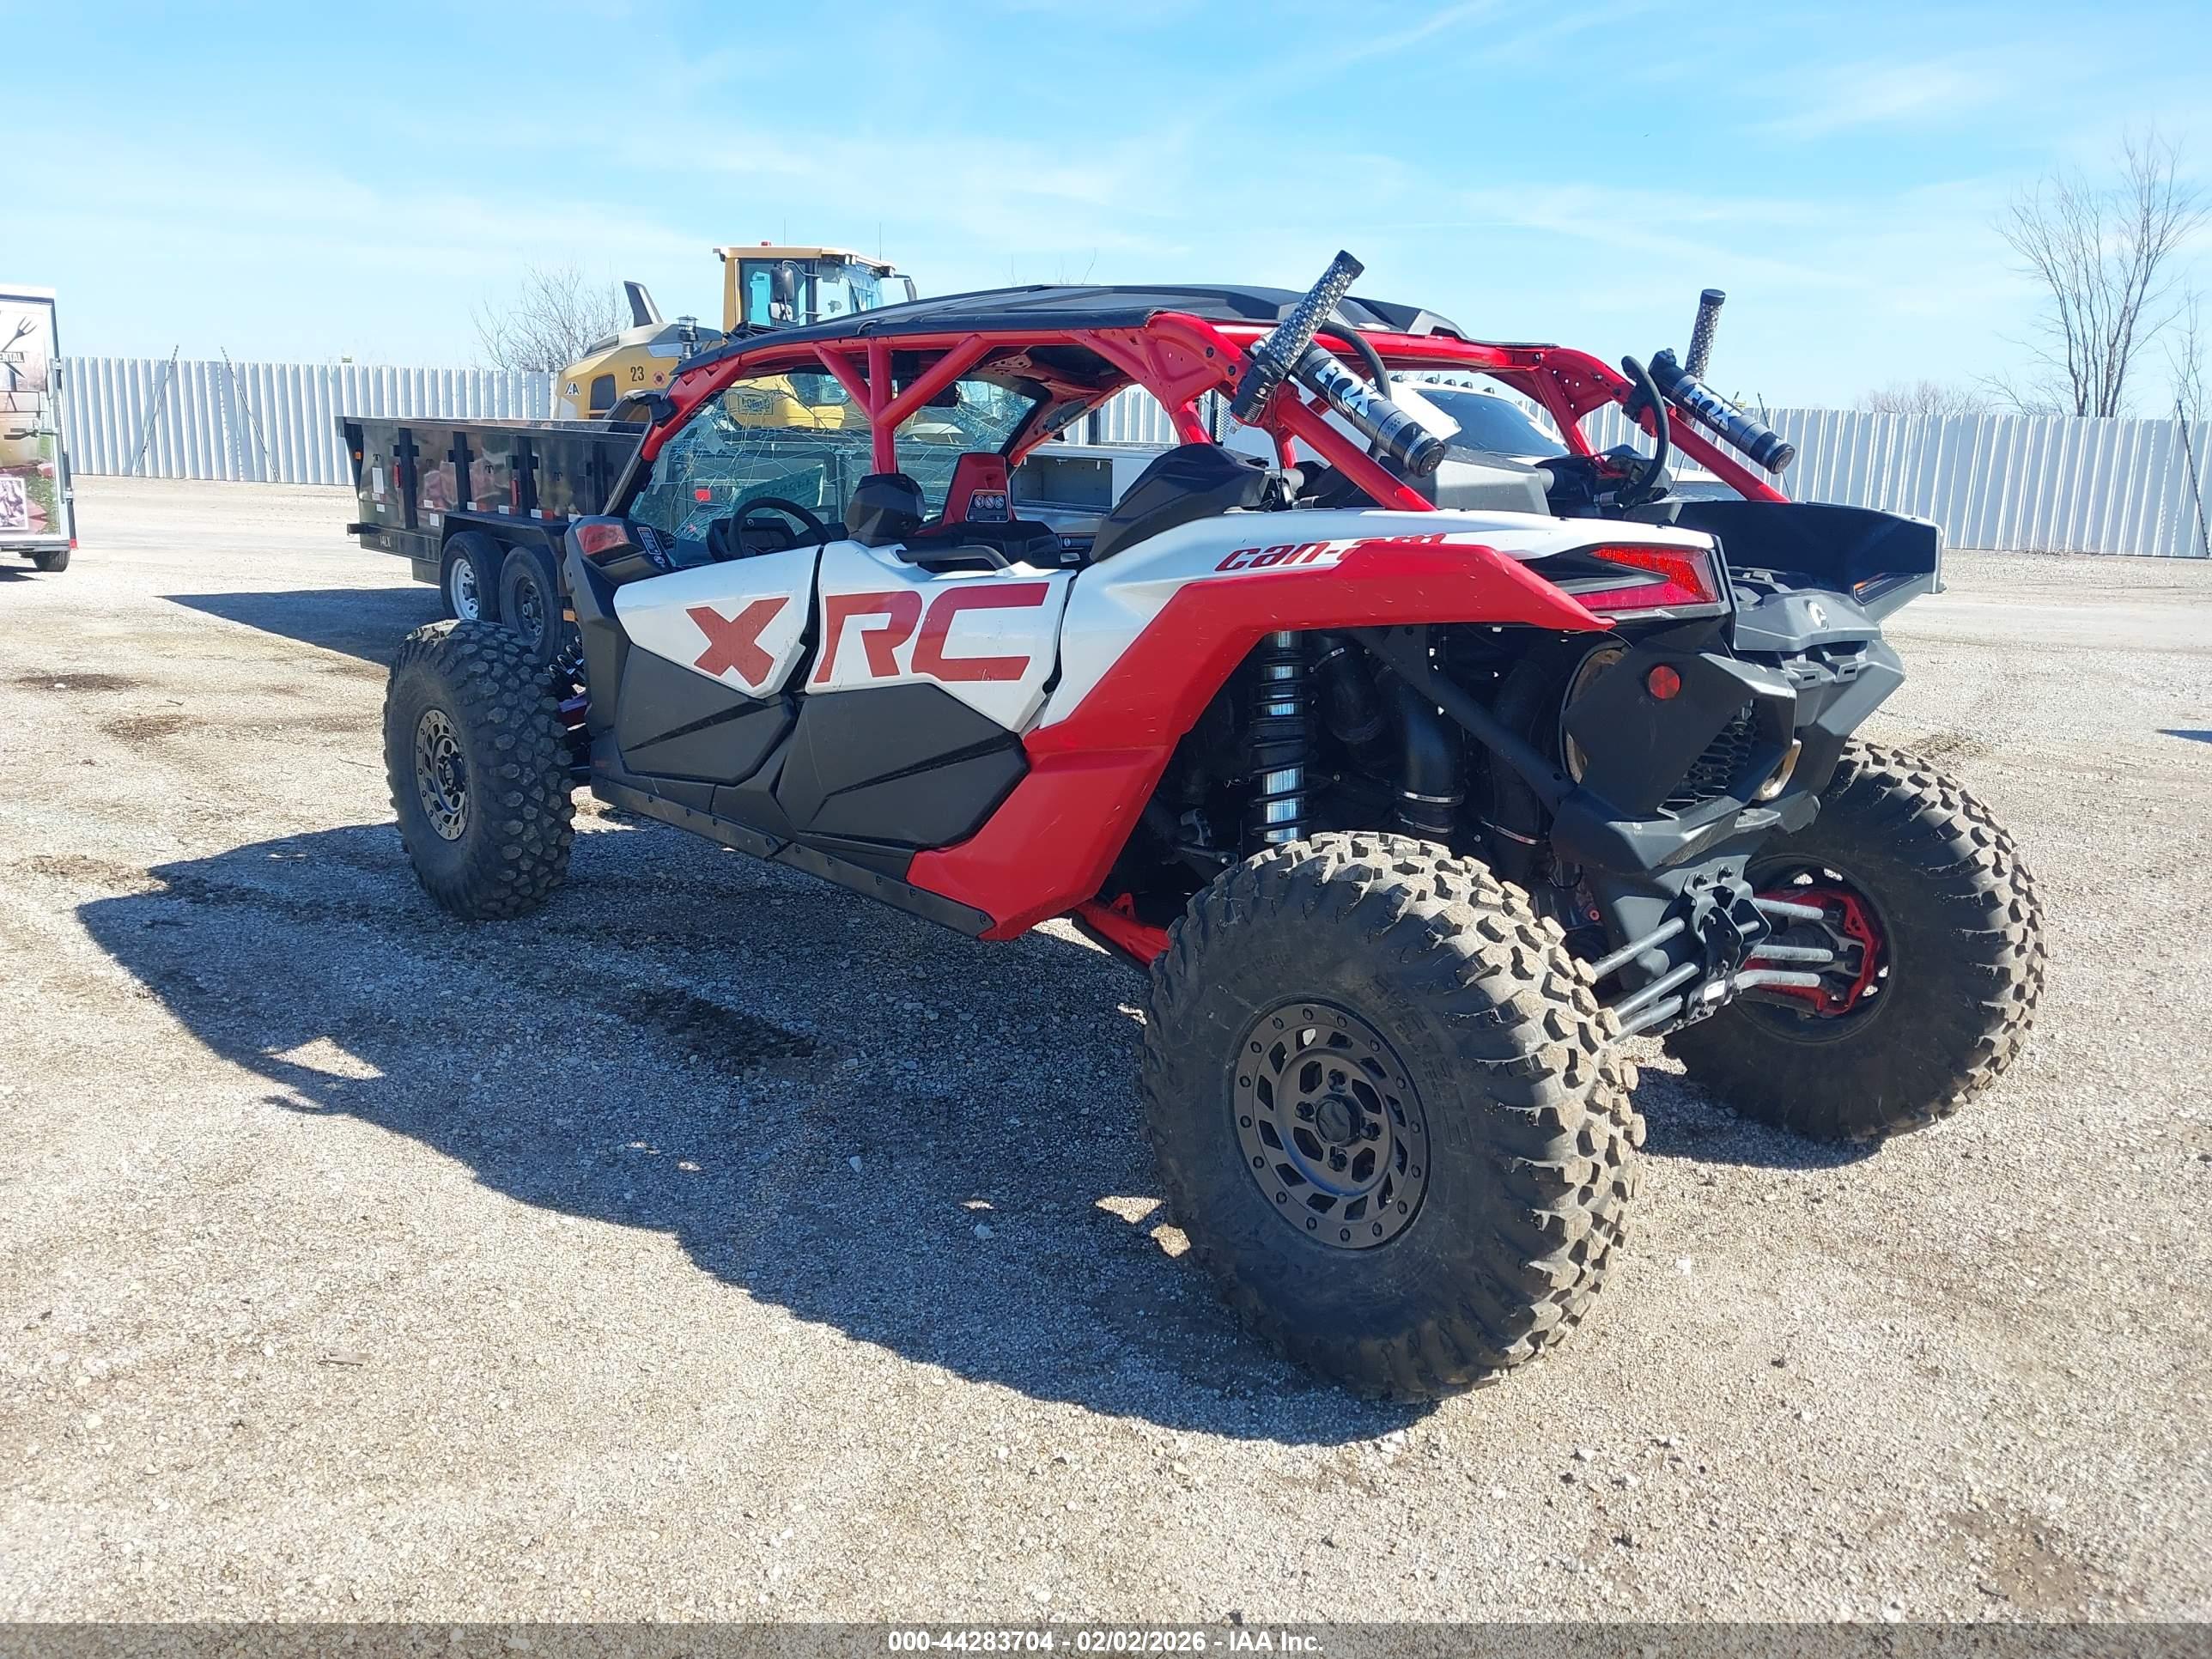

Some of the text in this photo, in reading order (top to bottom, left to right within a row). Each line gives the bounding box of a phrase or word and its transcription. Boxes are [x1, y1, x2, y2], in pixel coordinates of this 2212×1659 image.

[629, 365, 645, 382] 23
[1315, 358, 1388, 419] FOX
[1683, 383, 1744, 432] FOX
